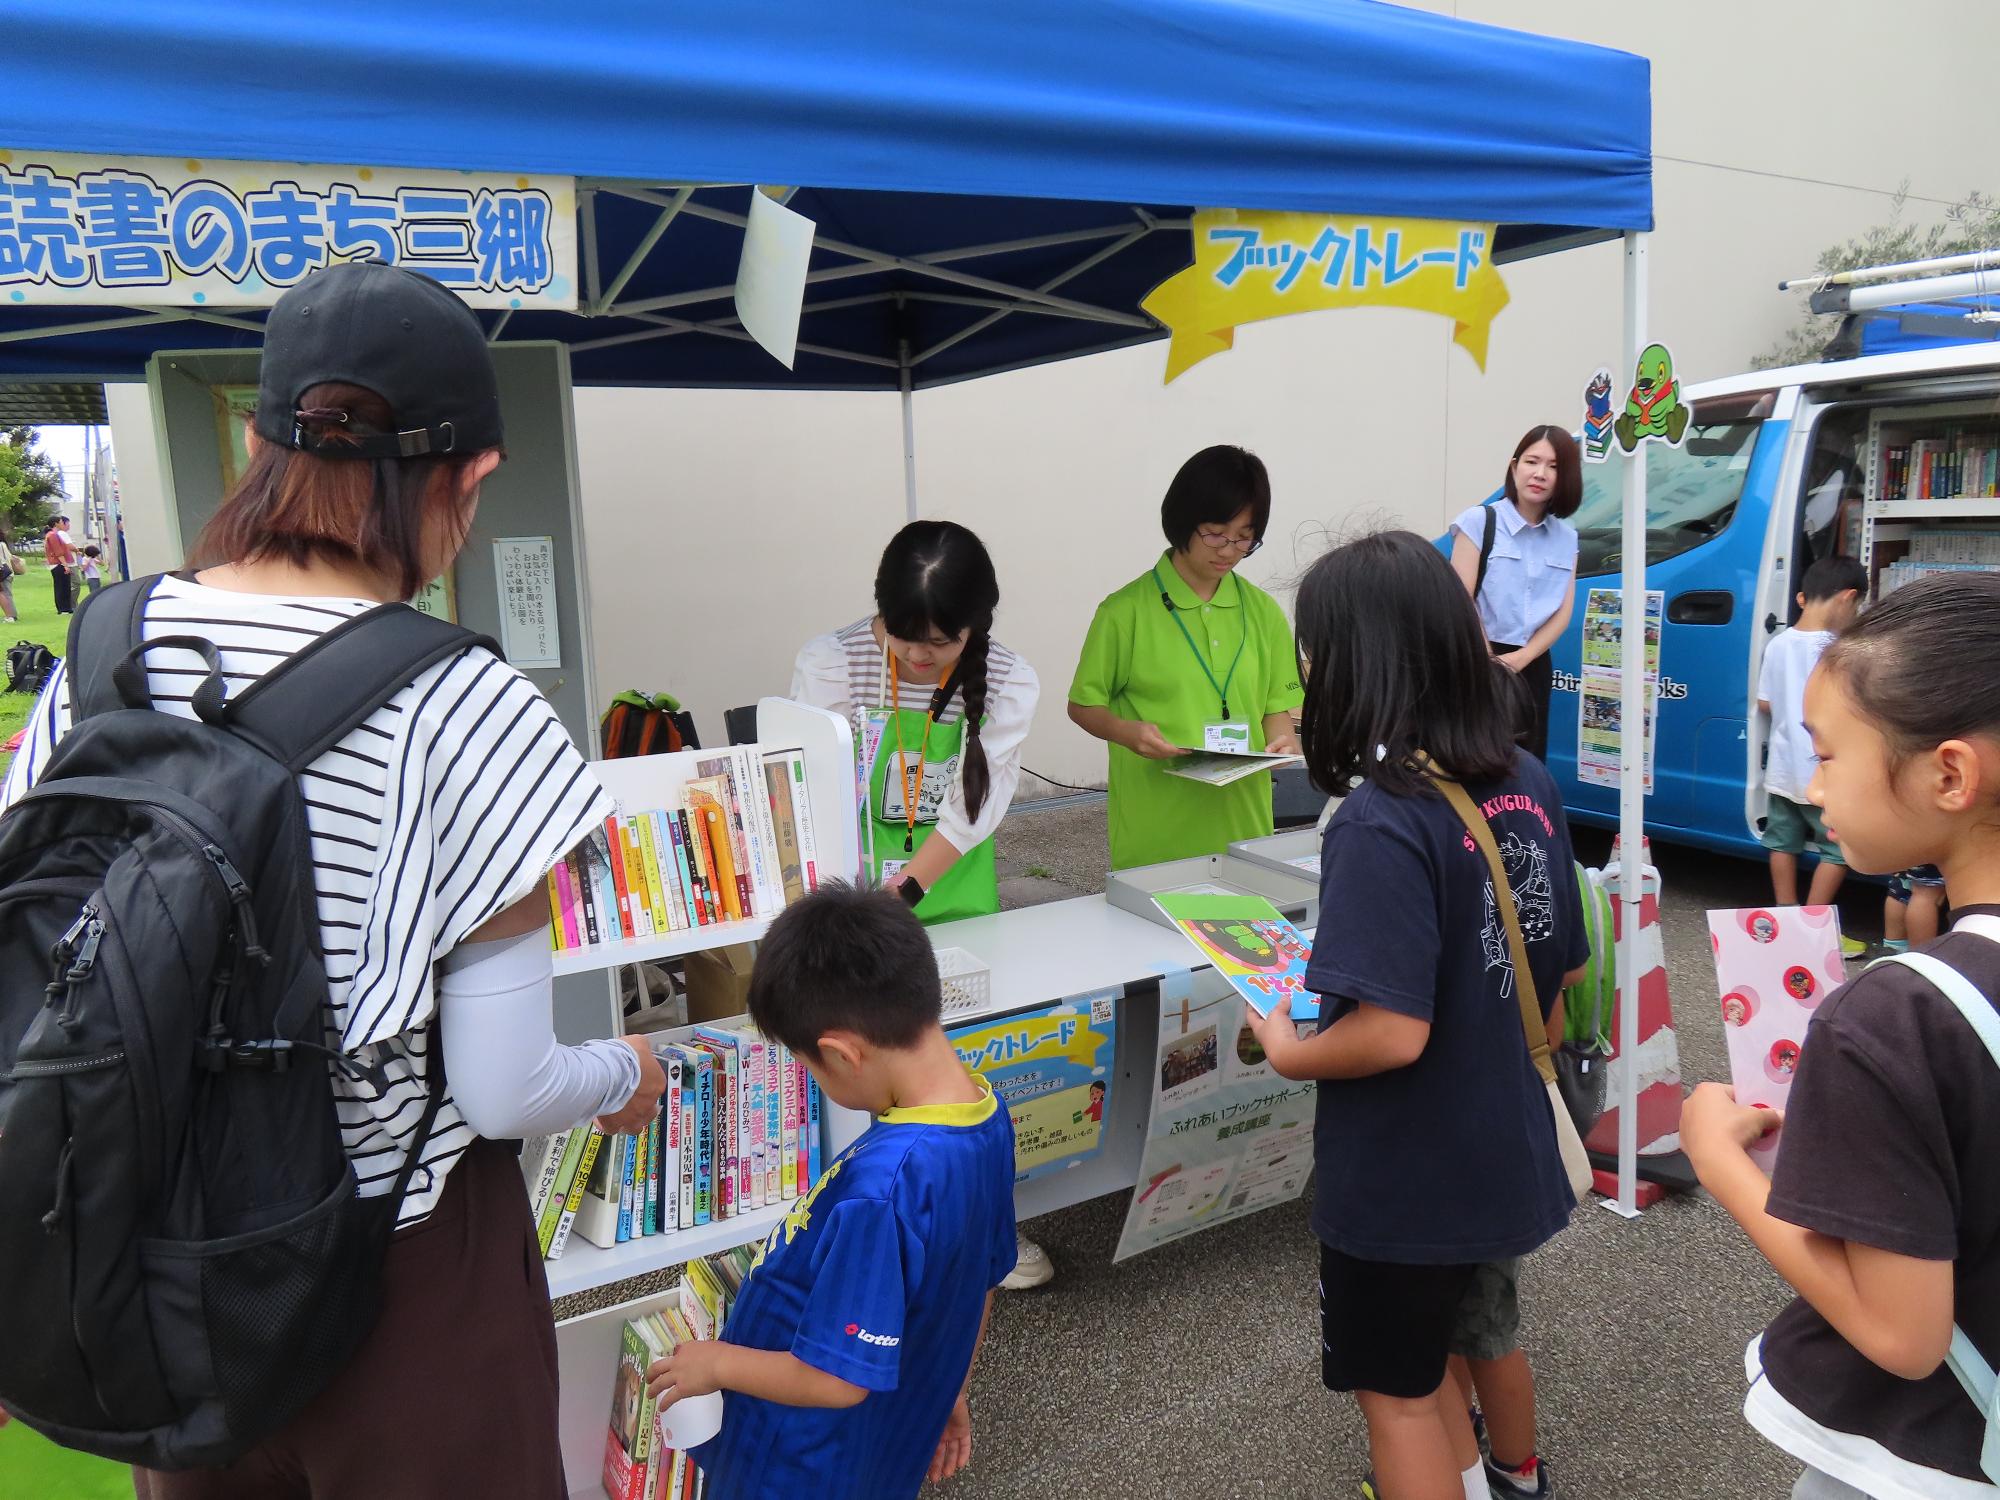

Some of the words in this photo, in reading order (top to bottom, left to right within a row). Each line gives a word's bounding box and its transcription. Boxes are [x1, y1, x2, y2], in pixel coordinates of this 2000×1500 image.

[0, 172, 551, 288] 読書のまち三郷
[1210, 226, 1485, 292] ブックトレード
[504, 554, 517, 618] いっぱい楽しもう
[513, 546, 527, 626] わくわく体験と公園を
[523, 553, 536, 625] おはなしを聞いたり
[540, 545, 550, 585] 青空の下で
[532, 553, 546, 656] お気に入りの本を見つけたり
[700, 1071, 710, 1161] イチローの少年時代
[1216, 1113, 1272, 1141] 養成講座
[683, 1136, 693, 1173] 日本男児
[857, 1328, 900, 1347] lotto
